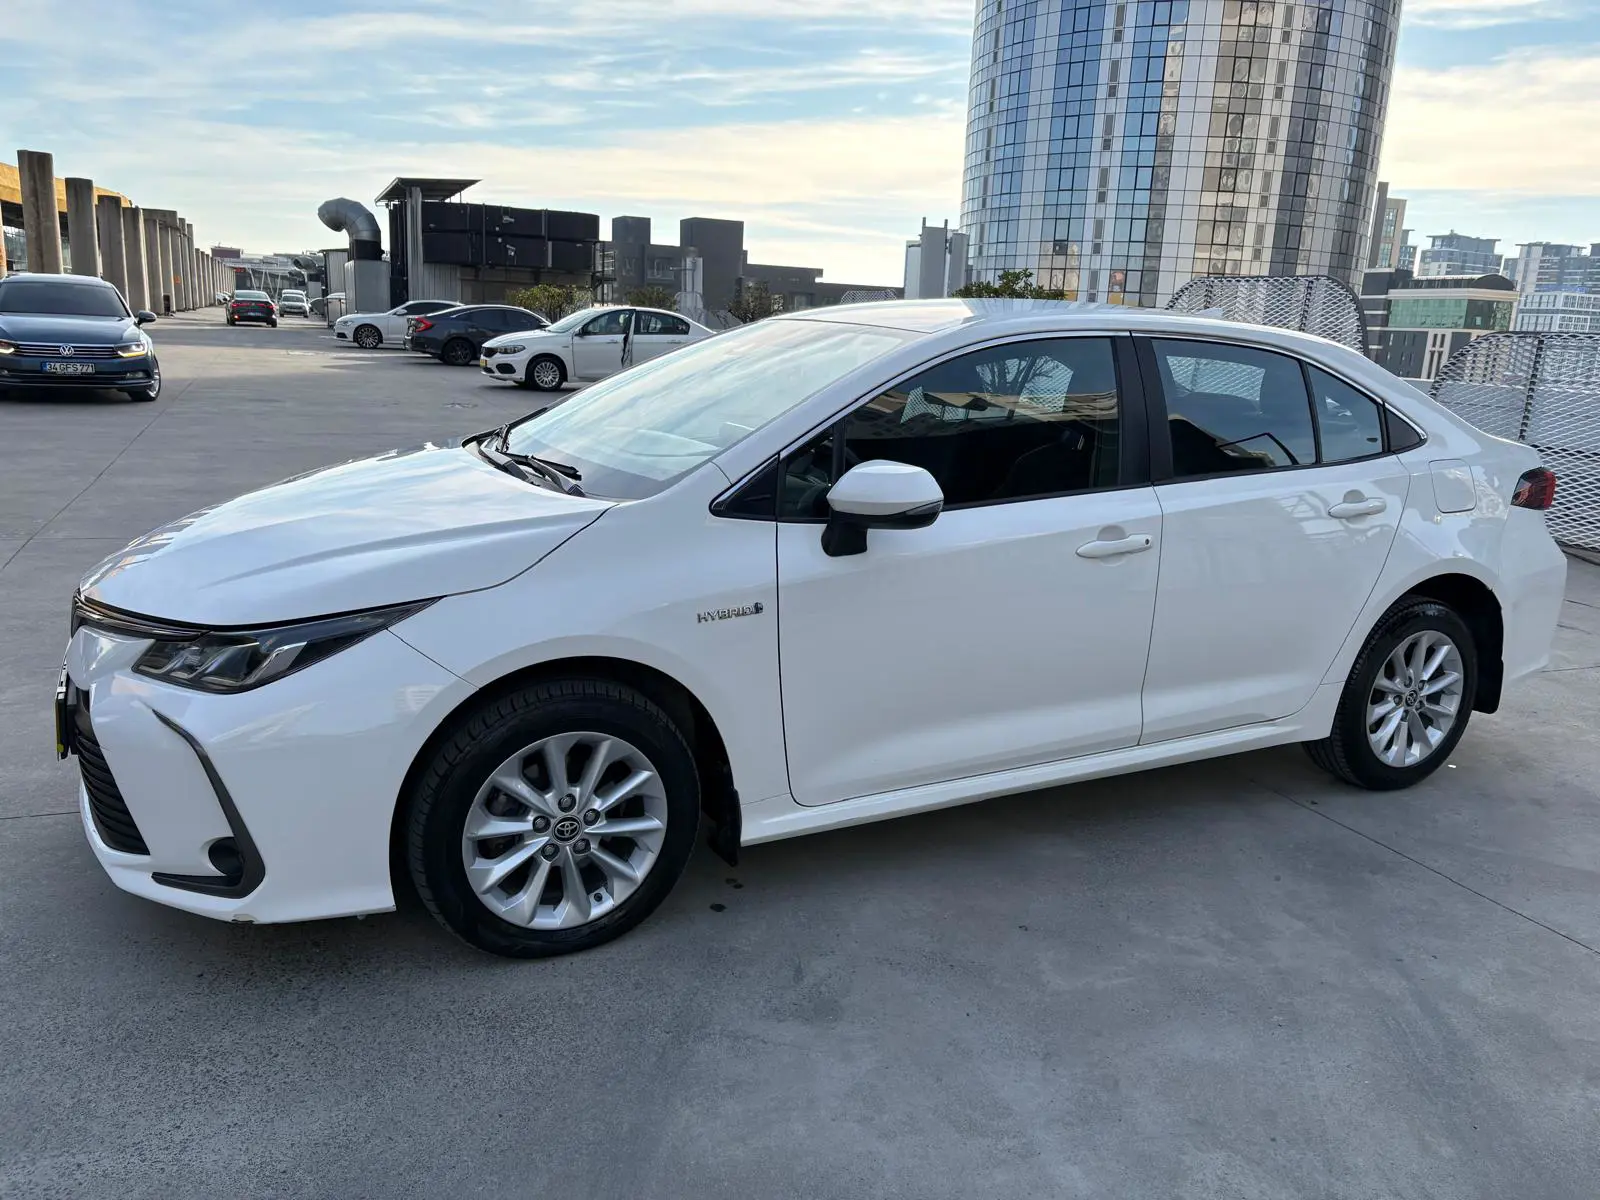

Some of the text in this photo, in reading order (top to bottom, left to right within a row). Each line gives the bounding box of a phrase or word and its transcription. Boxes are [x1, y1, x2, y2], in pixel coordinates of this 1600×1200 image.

[48, 363, 58, 371] 34
[80, 364, 95, 372] 771
[697, 605, 753, 623] HYBRID
